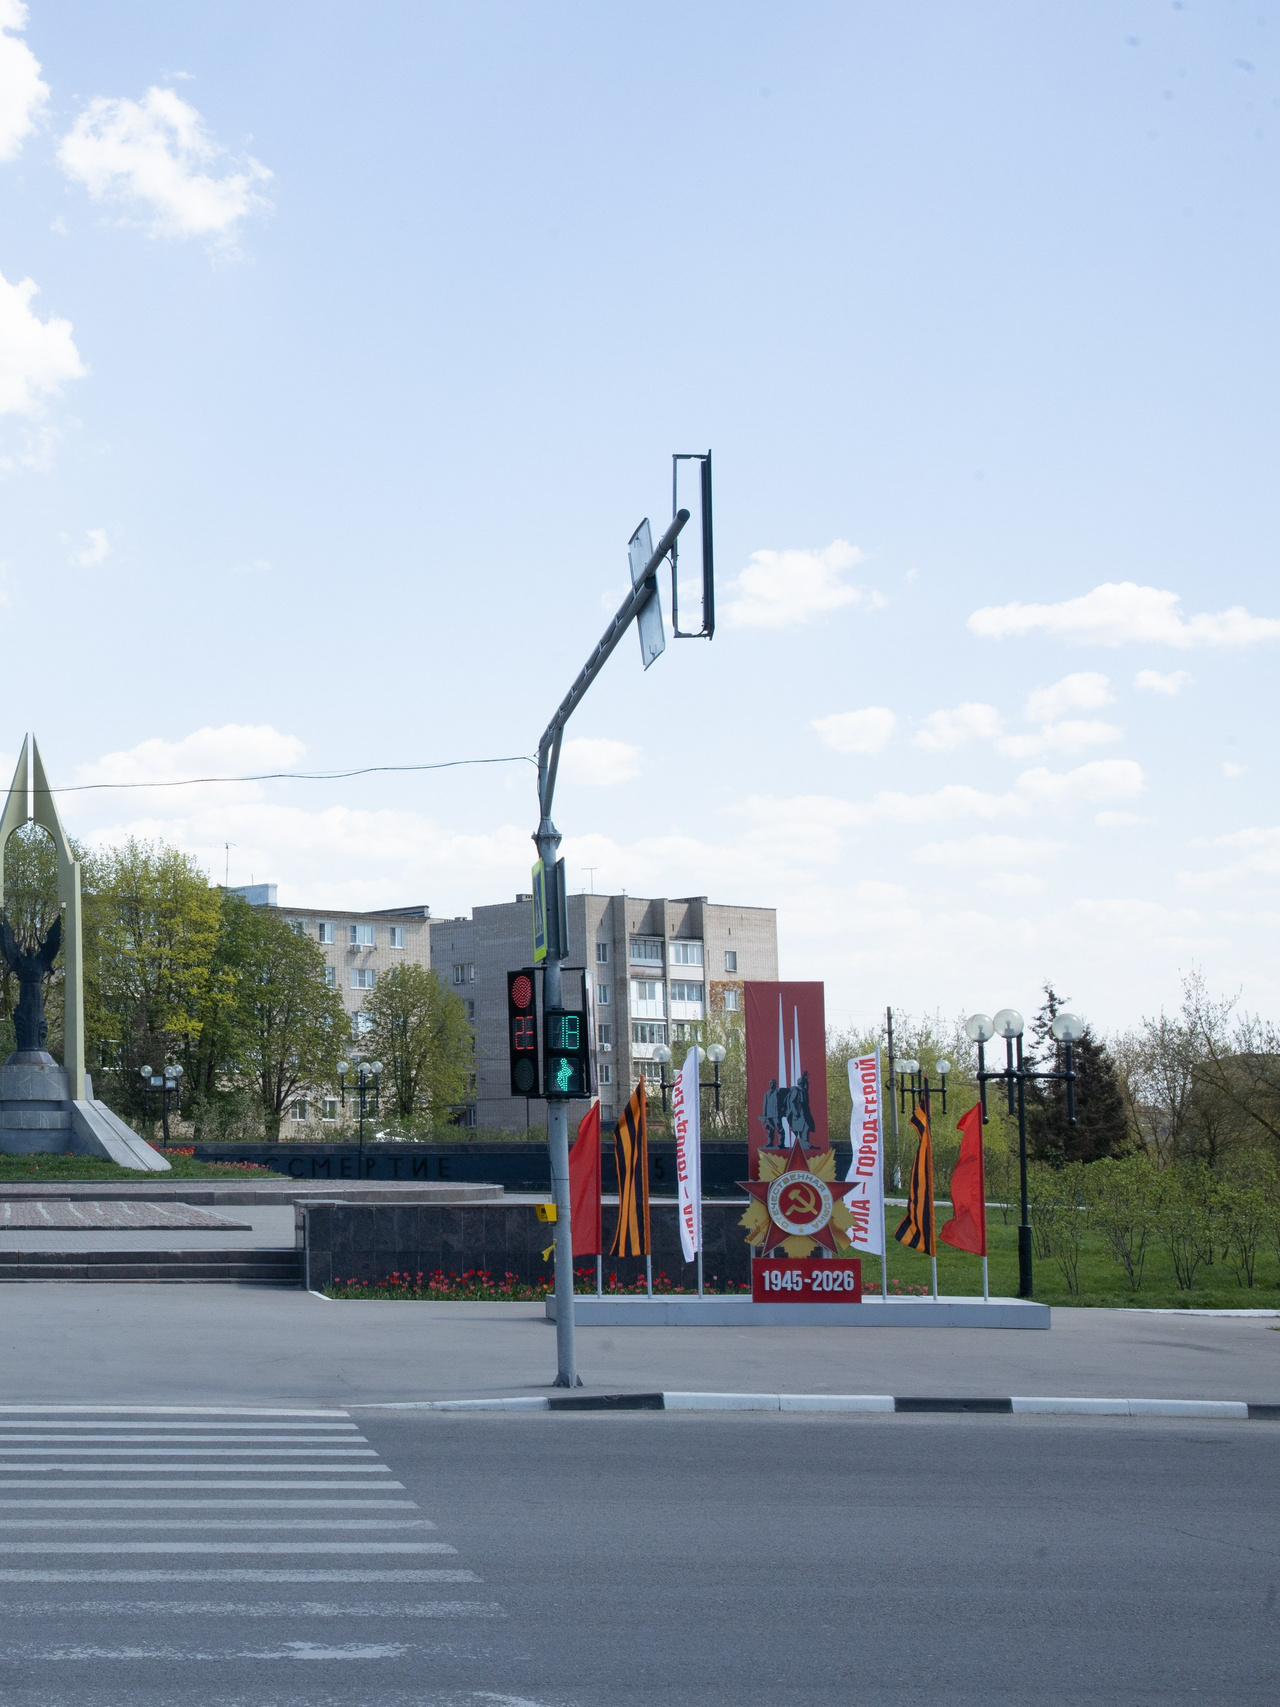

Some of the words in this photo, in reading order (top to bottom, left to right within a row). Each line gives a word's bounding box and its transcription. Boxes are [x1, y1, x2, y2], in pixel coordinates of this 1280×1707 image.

[562, 1015, 579, 1050] 18
[854, 1057, 878, 1177] ГОРОД-ГЕРОЙ
[762, 1270, 854, 1291] 1945-2026
